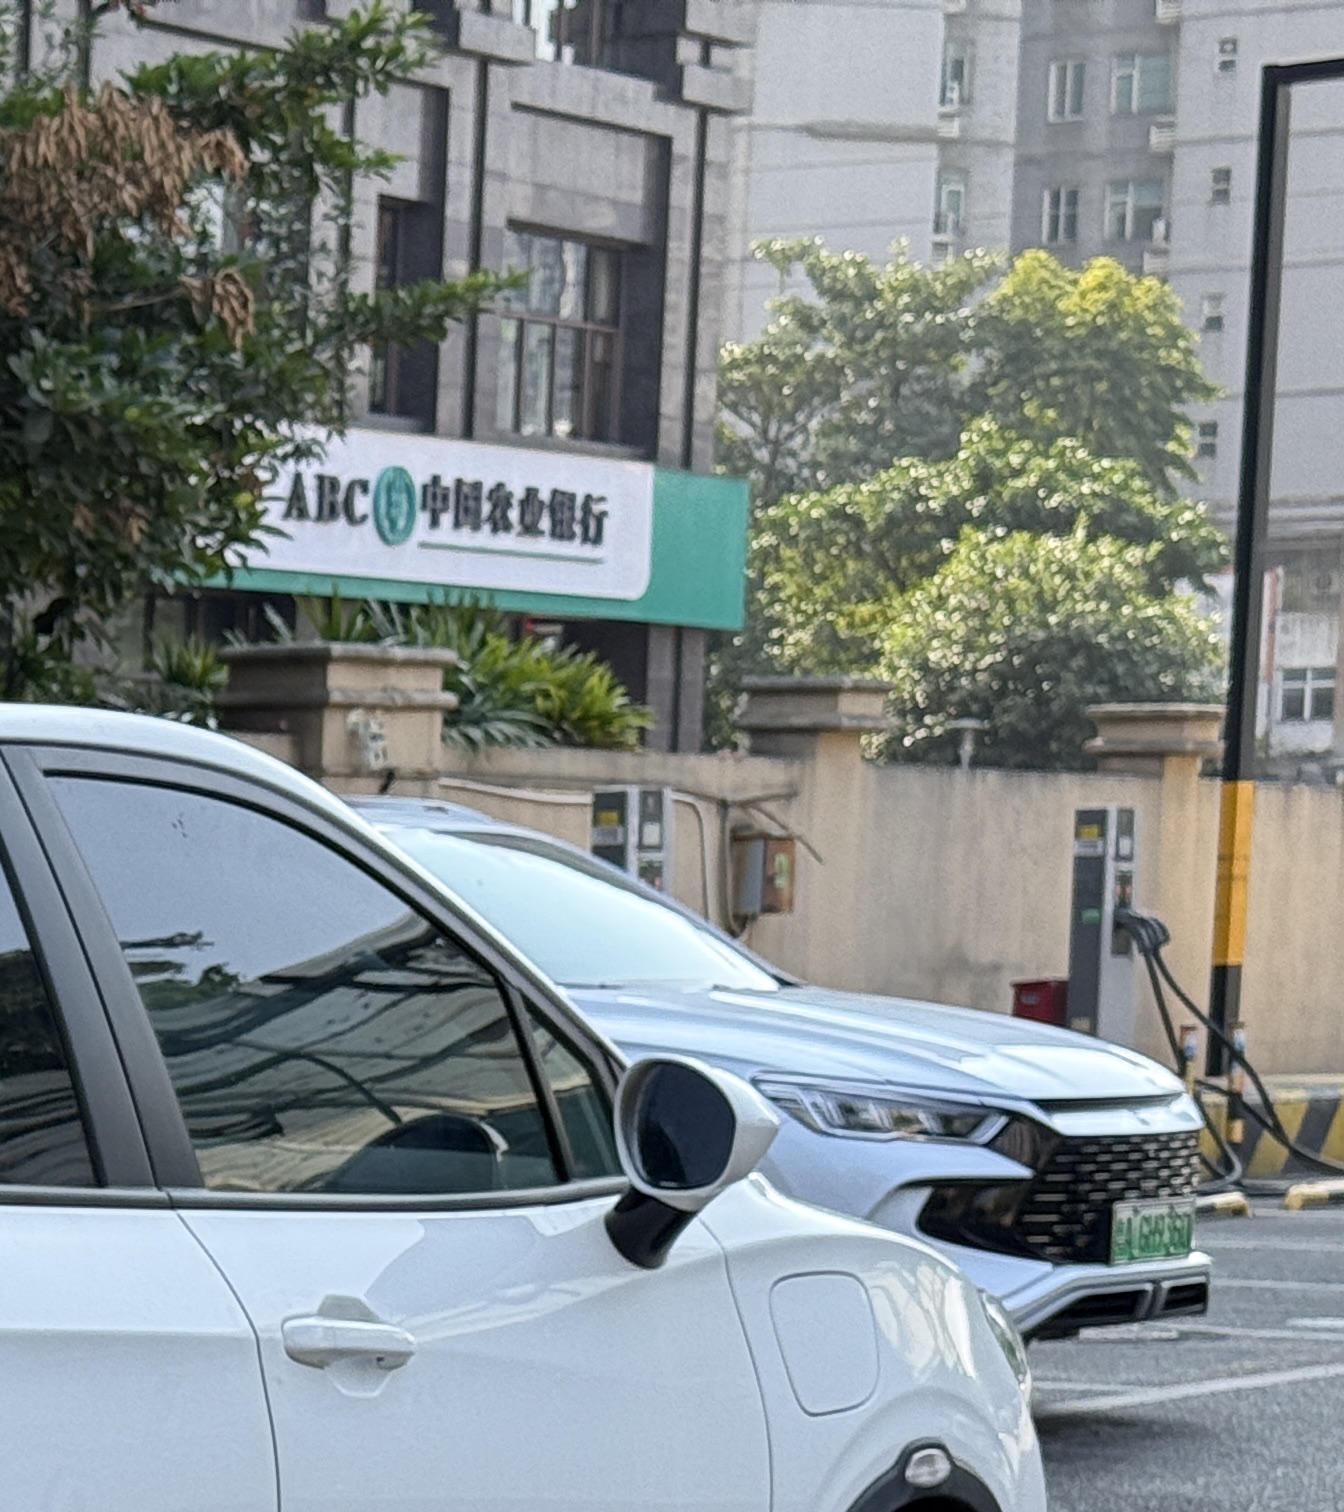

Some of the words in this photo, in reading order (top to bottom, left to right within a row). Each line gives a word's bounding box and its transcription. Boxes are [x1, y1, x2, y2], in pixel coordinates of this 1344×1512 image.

[285, 472, 370, 526] ABC
[421, 474, 609, 546] 中国农业银行
